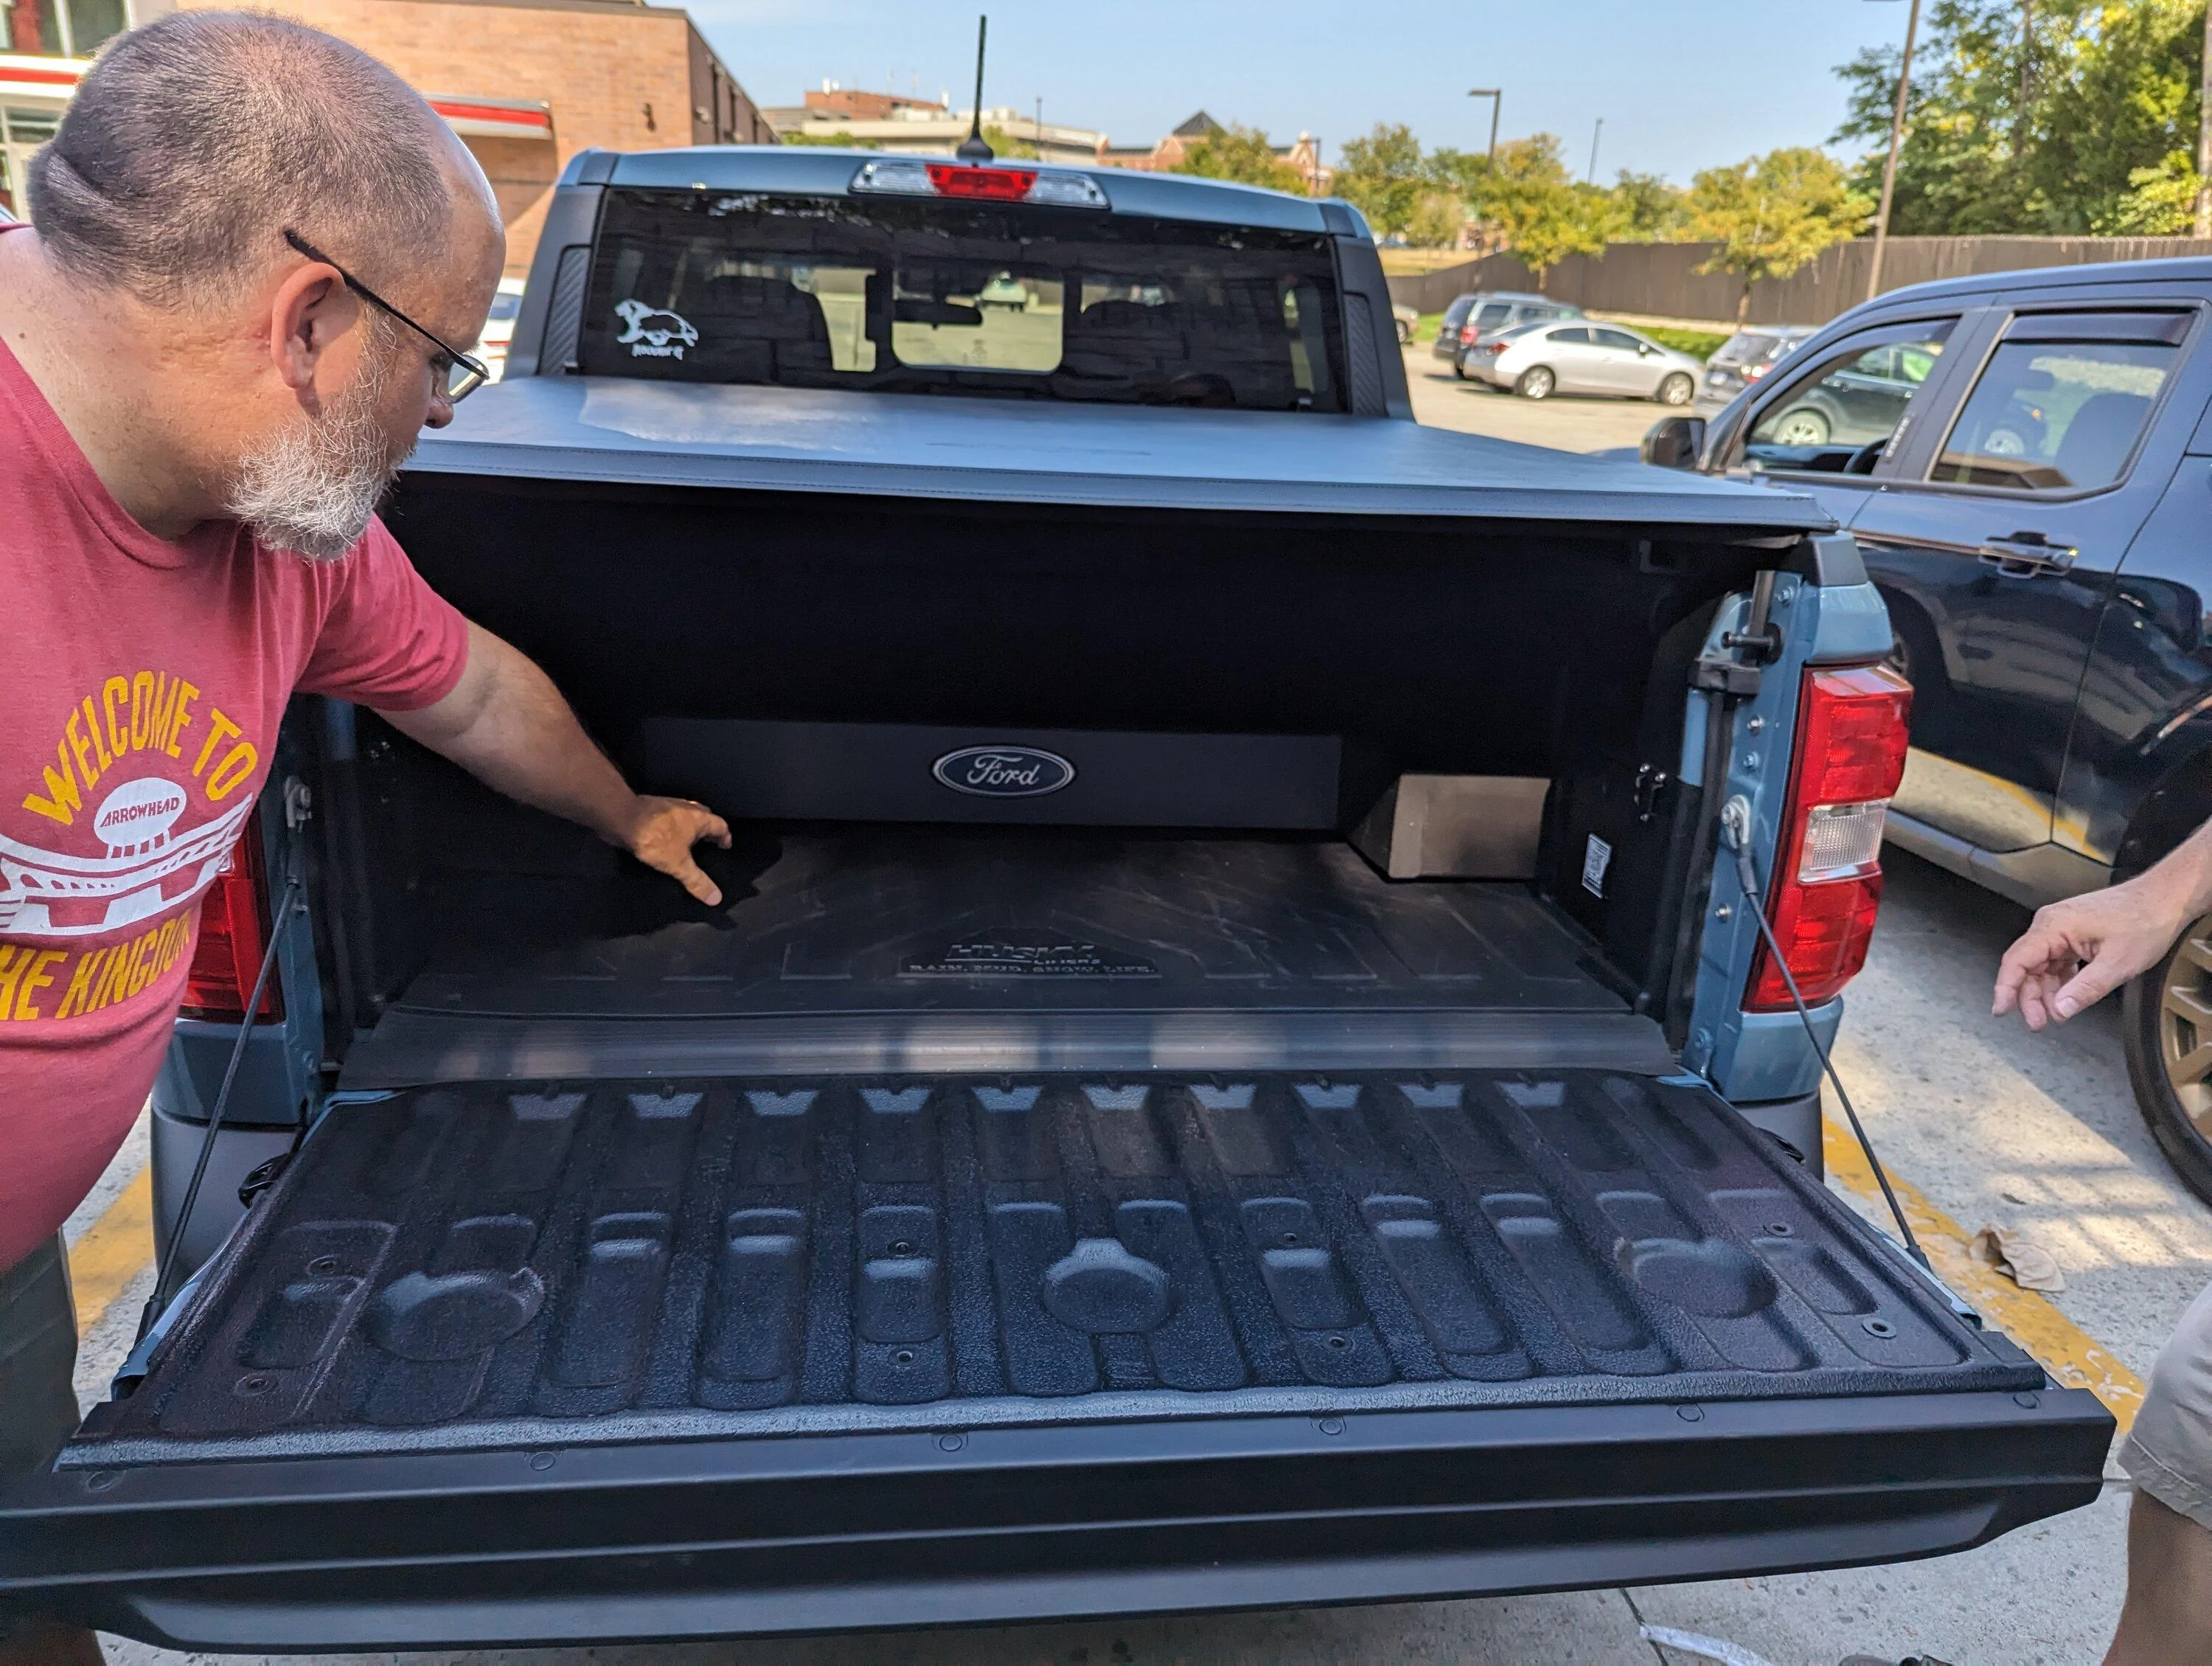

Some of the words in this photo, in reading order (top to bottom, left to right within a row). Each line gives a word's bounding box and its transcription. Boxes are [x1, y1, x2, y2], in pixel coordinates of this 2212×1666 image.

[24, 670, 200, 825] WELCOME
[192, 708, 258, 801] TO
[967, 754, 1041, 785] Ford
[100, 796, 180, 827] ARROWHEAD
[0, 944, 69, 1021] HE
[55, 909, 190, 1019] KINGDOM
